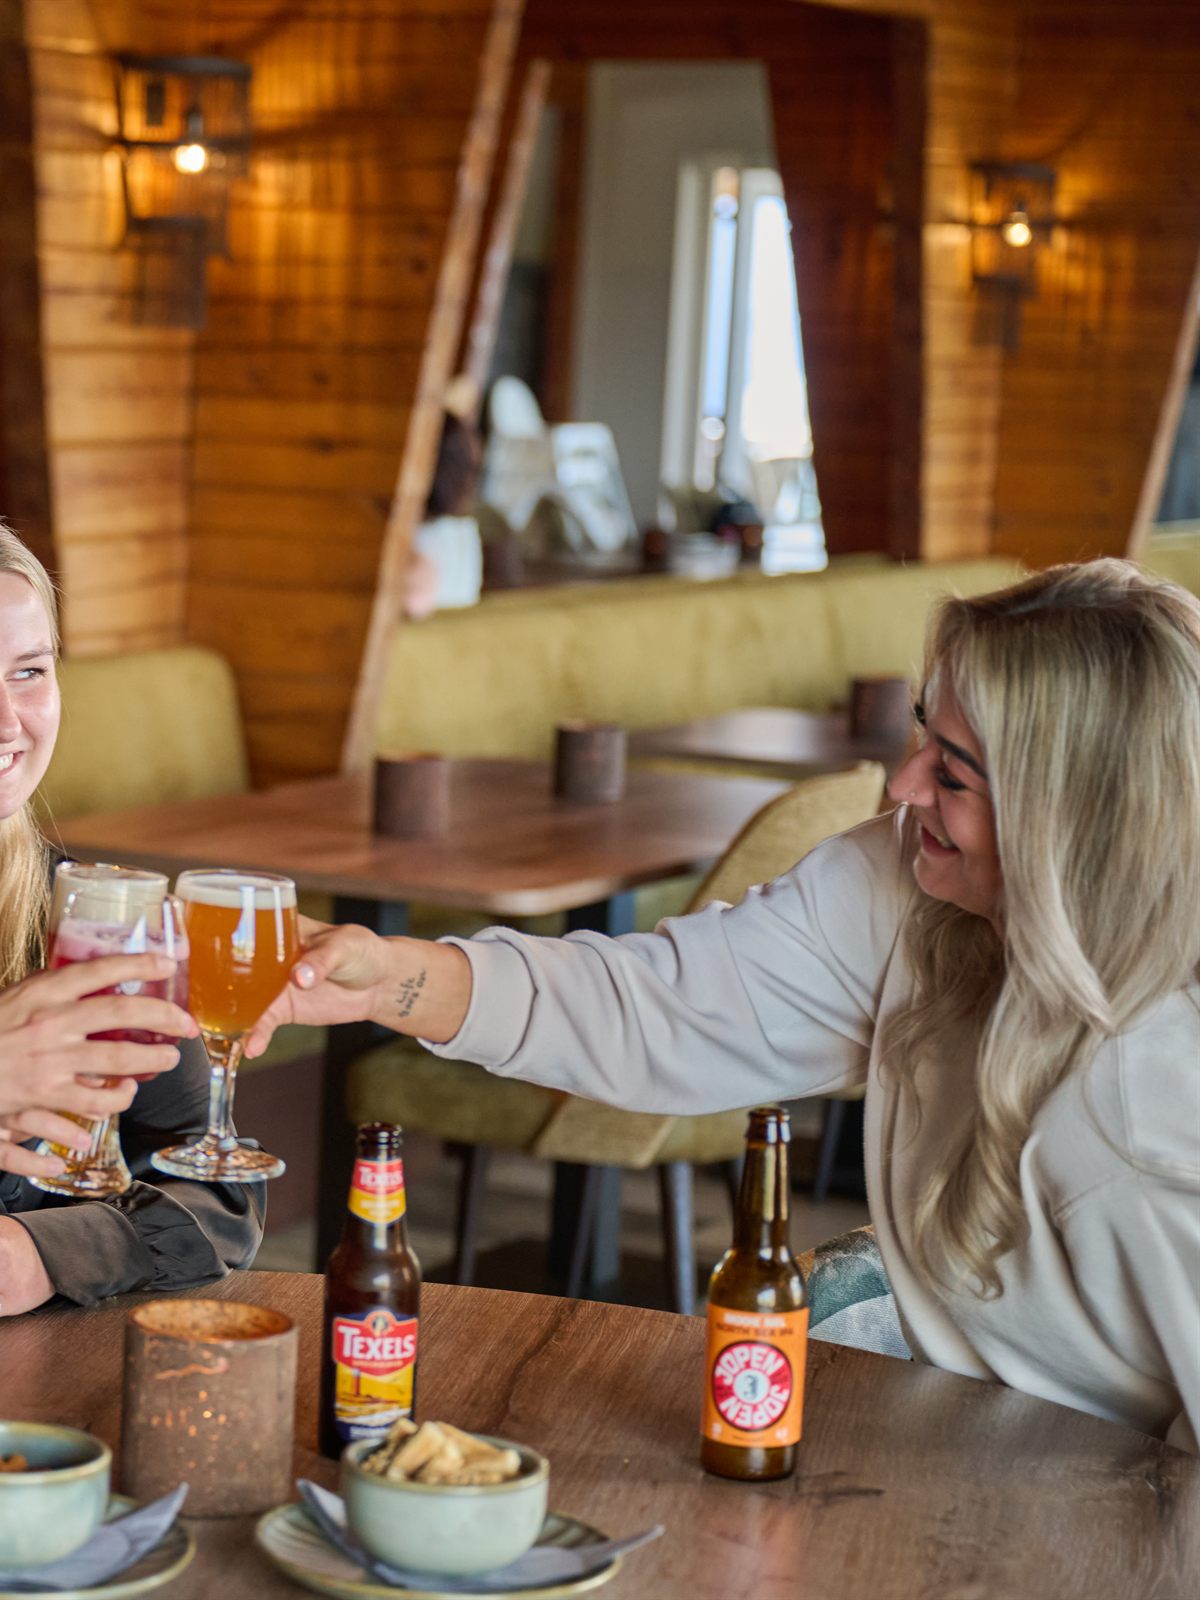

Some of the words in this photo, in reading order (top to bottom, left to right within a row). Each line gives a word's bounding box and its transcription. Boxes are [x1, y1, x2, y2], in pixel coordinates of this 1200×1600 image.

[338, 1326, 416, 1360] TEXELS
[714, 1345, 784, 1386] JOPEN
[720, 1384, 790, 1430] JOPEN
